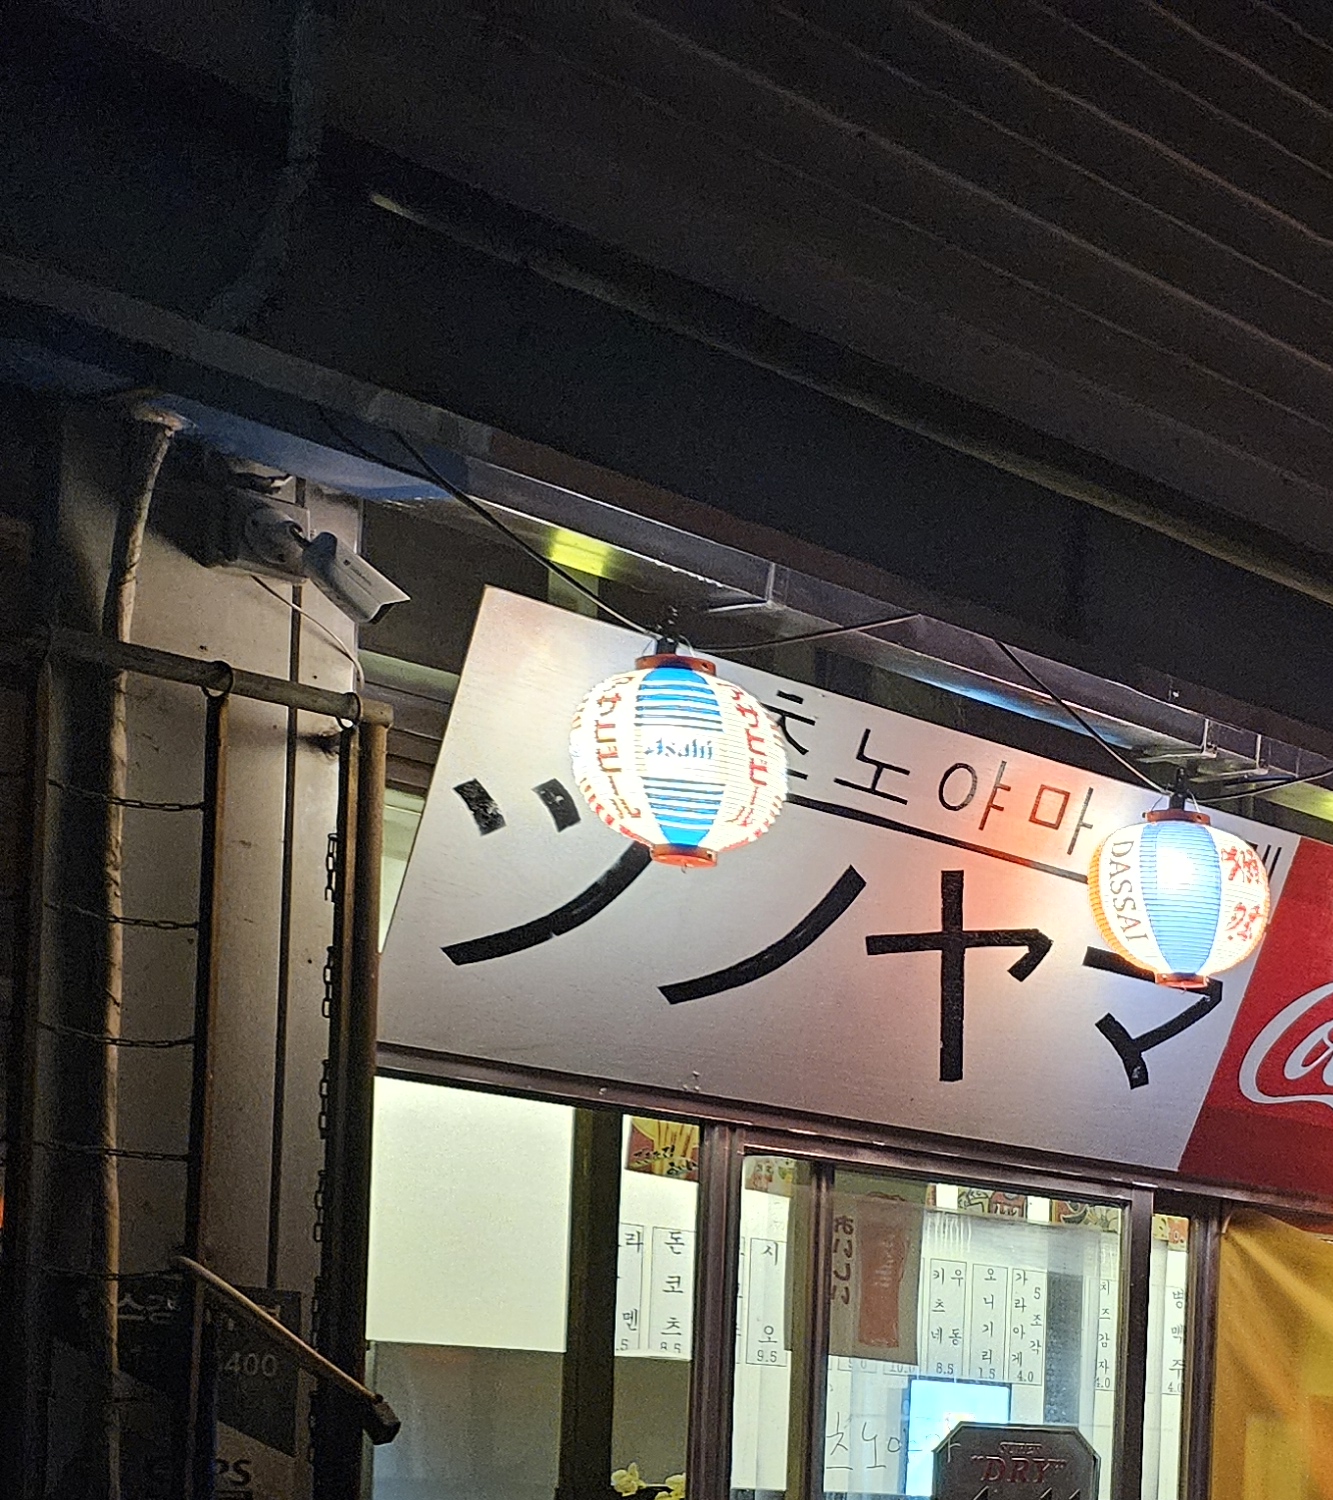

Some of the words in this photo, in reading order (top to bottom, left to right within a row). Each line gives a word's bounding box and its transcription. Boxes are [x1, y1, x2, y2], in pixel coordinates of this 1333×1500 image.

[1109, 840, 1149, 942] DASSAI
[981, 1267, 997, 1366] 오니기리
[1011, 1269, 1029, 1368] 가라아게
[756, 1350, 778, 1363] 9.5
[935, 1362, 954, 1375] 8.5
[1016, 1369, 1035, 1383] 4.0
